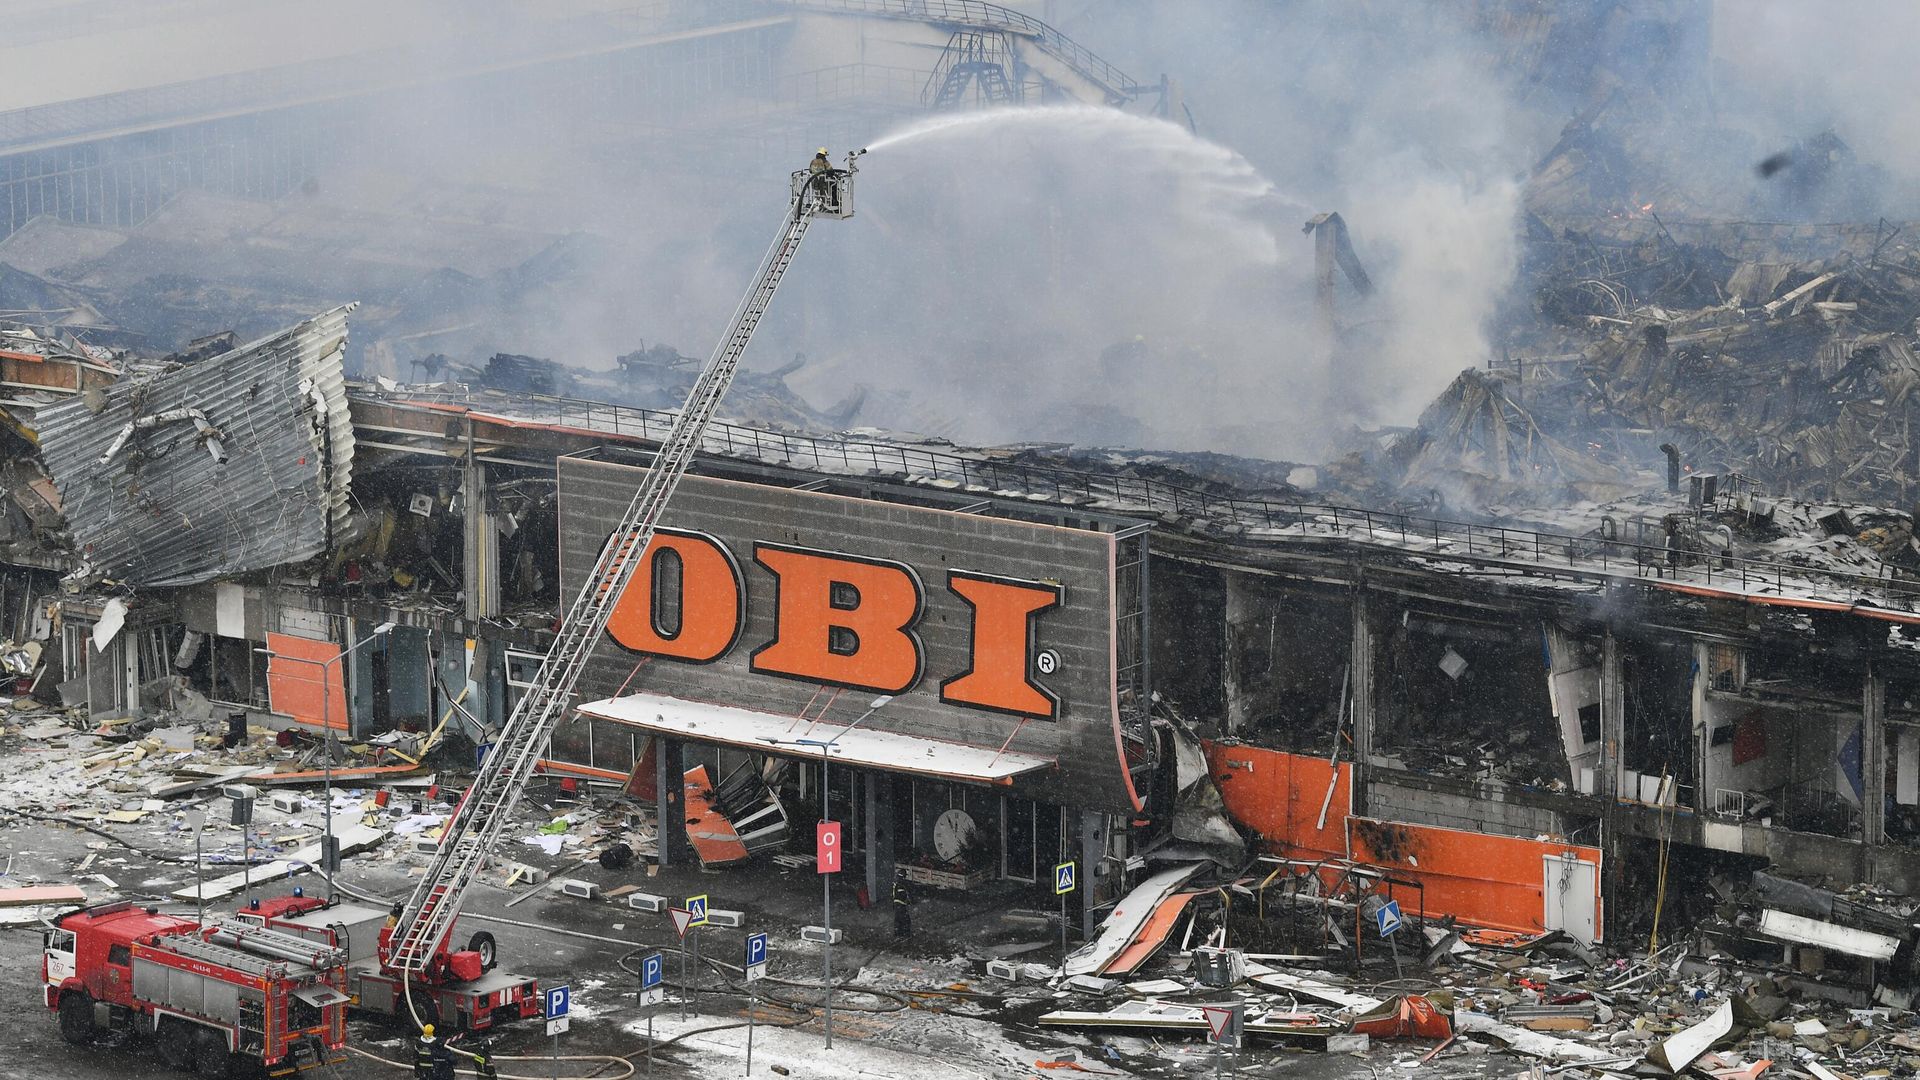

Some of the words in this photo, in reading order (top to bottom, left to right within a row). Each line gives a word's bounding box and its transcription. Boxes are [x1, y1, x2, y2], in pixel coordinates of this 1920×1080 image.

[600, 526, 1066, 722] OBI
[751, 939, 762, 962] P
[52, 961, 64, 972] 267
[647, 959, 659, 984] P
[513, 986, 520, 997] 11
[552, 990, 564, 1015] P
